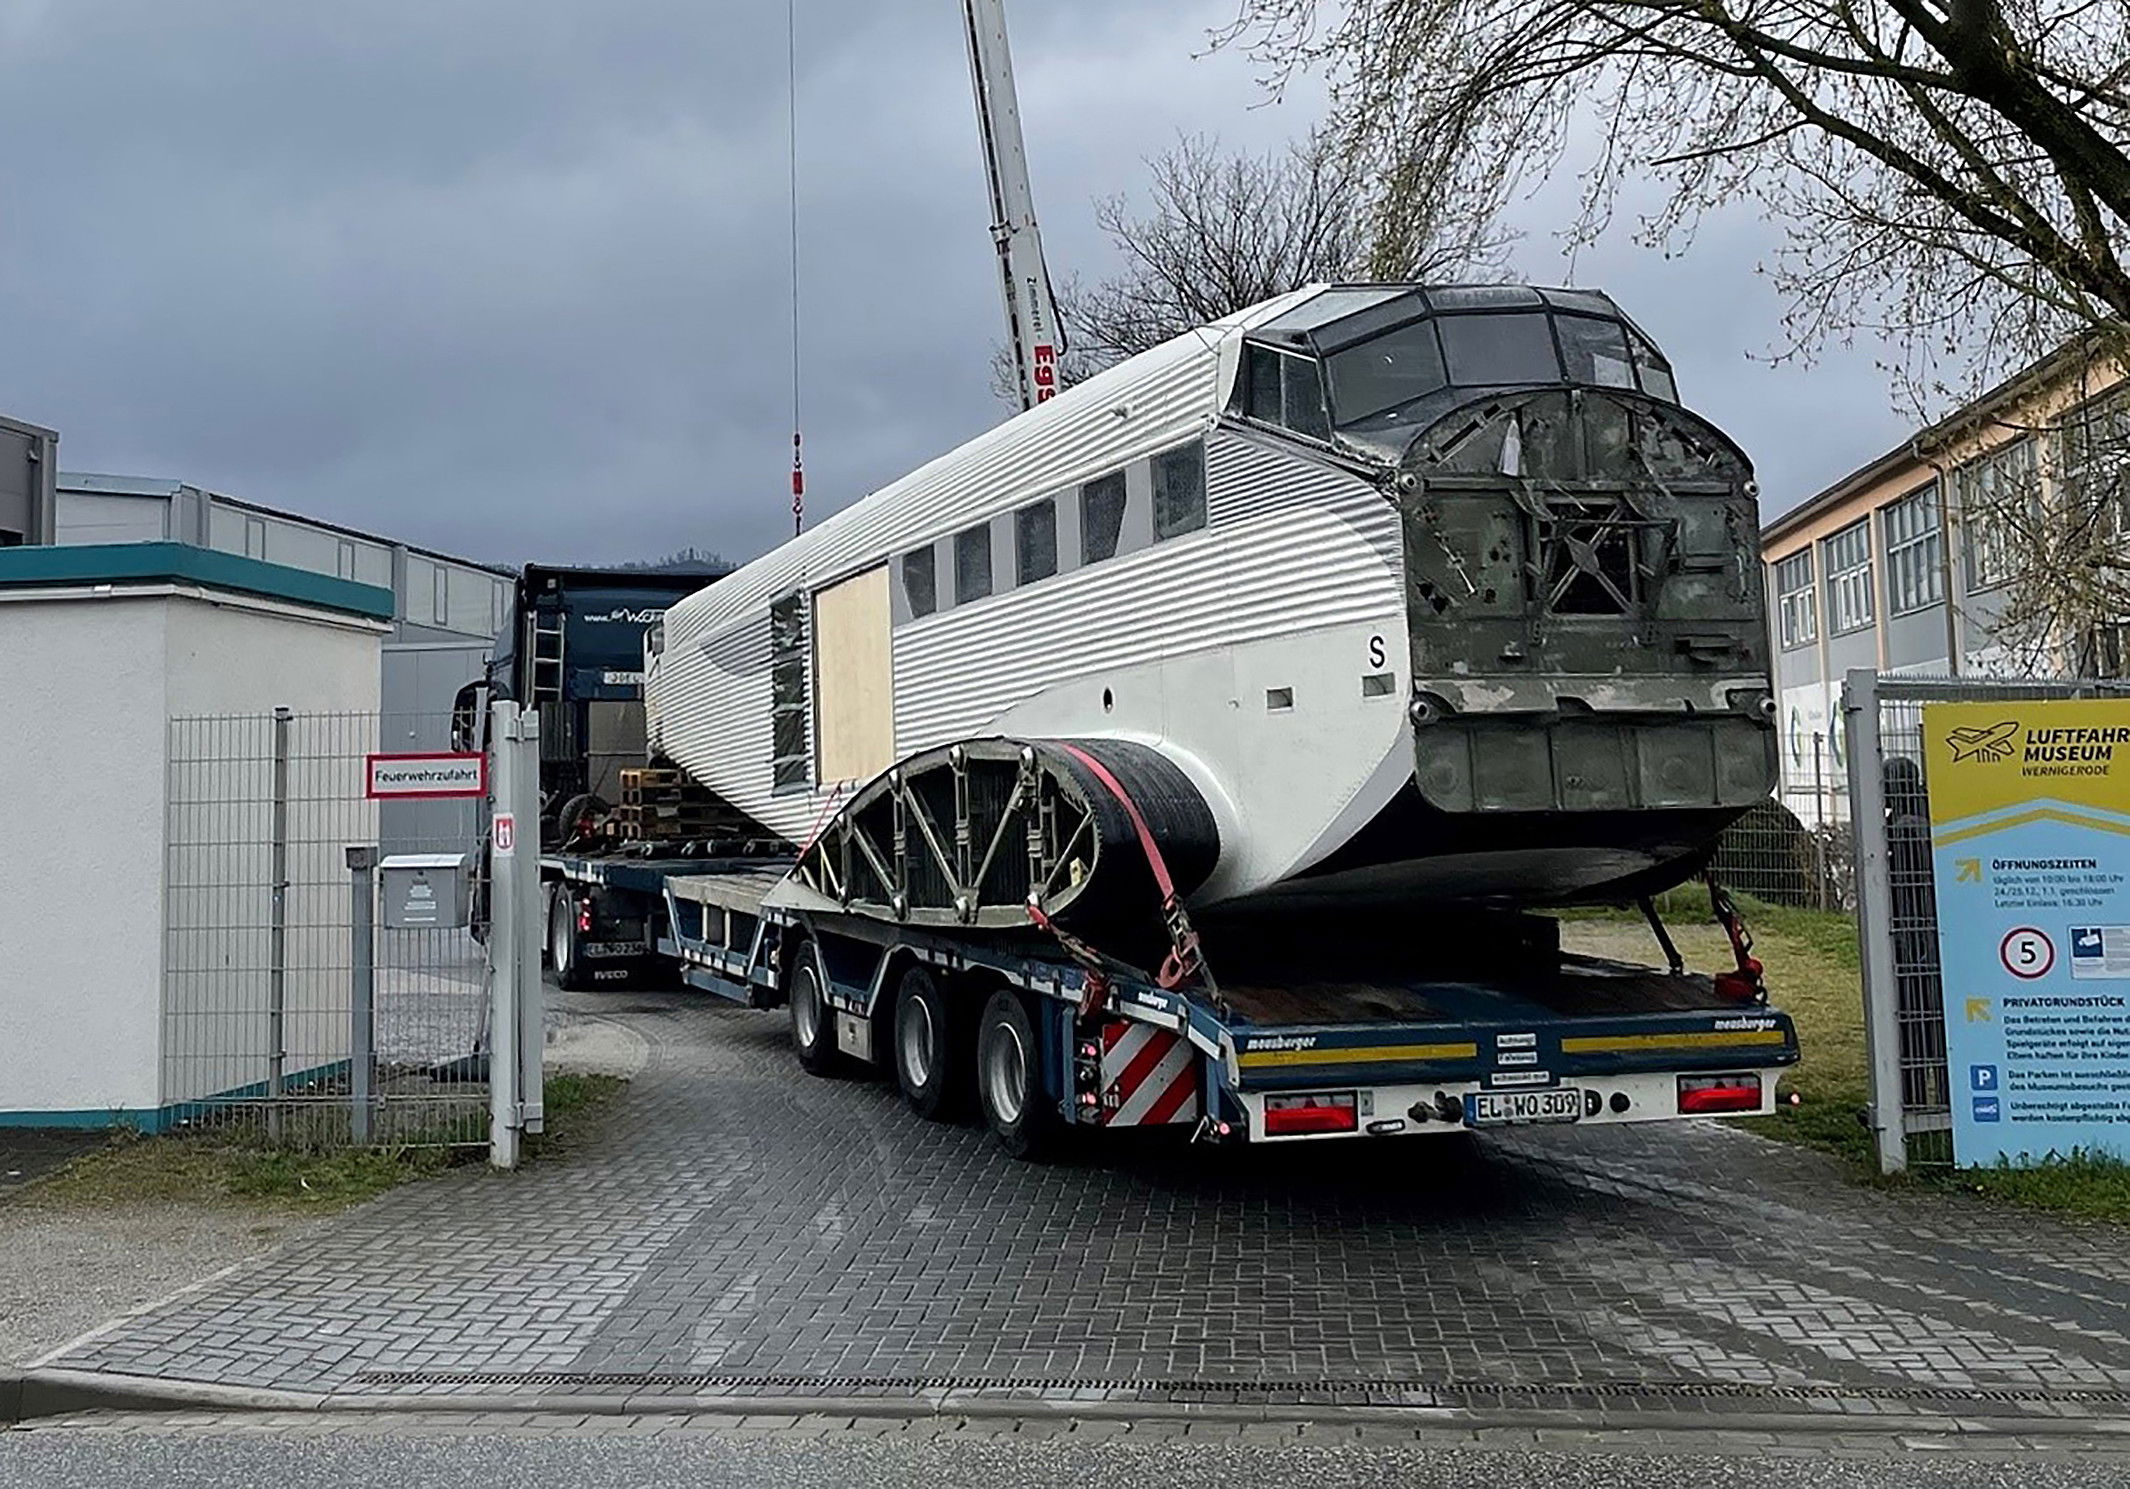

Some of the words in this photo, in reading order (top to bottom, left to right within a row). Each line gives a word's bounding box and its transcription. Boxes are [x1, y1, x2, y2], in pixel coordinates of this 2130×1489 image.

[1377, 638, 1397, 679] S
[2026, 727, 2130, 744] LUFTFAHR
[2024, 745, 2113, 762] MUSEUM
[375, 769, 477, 783] Feuerwehrzufahrt
[2022, 765, 2110, 776] WERNIGERODE
[1992, 858, 2097, 870] ÖFFNUNGSZEITEN
[2020, 941, 2036, 964] 5
[594, 970, 628, 980] IVECO
[2003, 994, 2125, 1008] PRIVATGRUNDSTÜCK
[1978, 1069, 1991, 1086] P
[1478, 1098, 1501, 1118] EL
[1514, 1095, 1537, 1116] WO
[1542, 1092, 1576, 1114] 309
